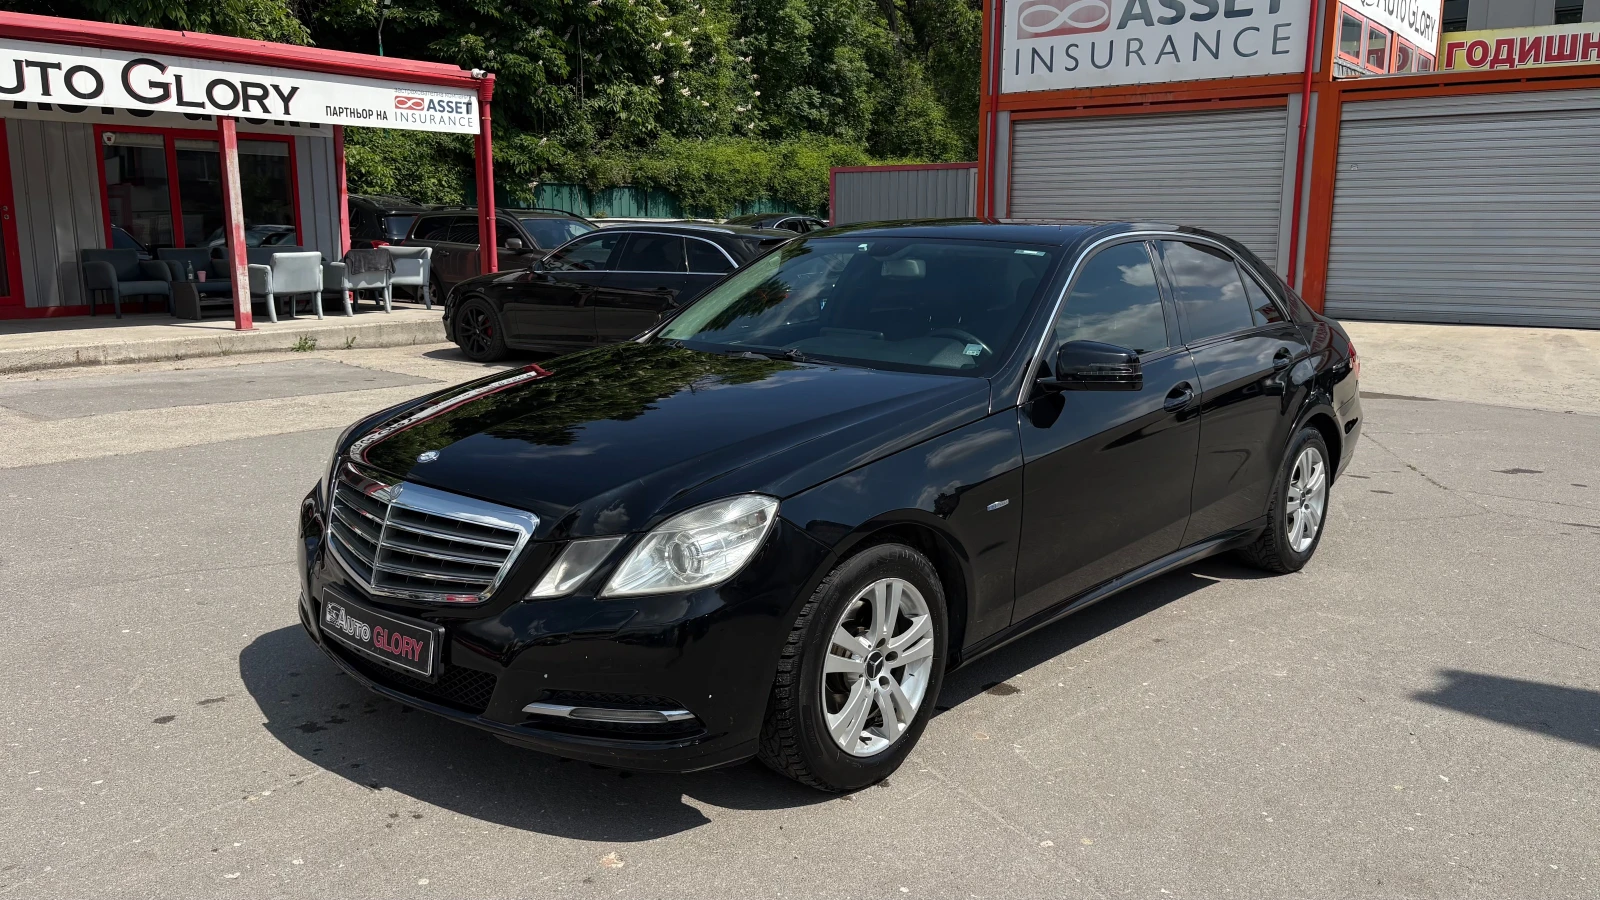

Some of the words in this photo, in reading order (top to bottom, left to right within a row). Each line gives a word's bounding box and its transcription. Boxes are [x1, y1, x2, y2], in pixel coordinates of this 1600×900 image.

[1408, 0, 1437, 43] GLORY
[1015, 22, 1292, 76] INSURANCE
[1444, 32, 1600, 70] ГОДИШН
[121, 58, 300, 116] GLORY
[426, 98, 473, 115] ASSET
[325, 105, 374, 120] ПАРТНЬОР
[376, 108, 389, 121] НА
[394, 111, 474, 128] INSURANCE
[338, 607, 371, 642] AUTO
[373, 625, 424, 662] GLORY
